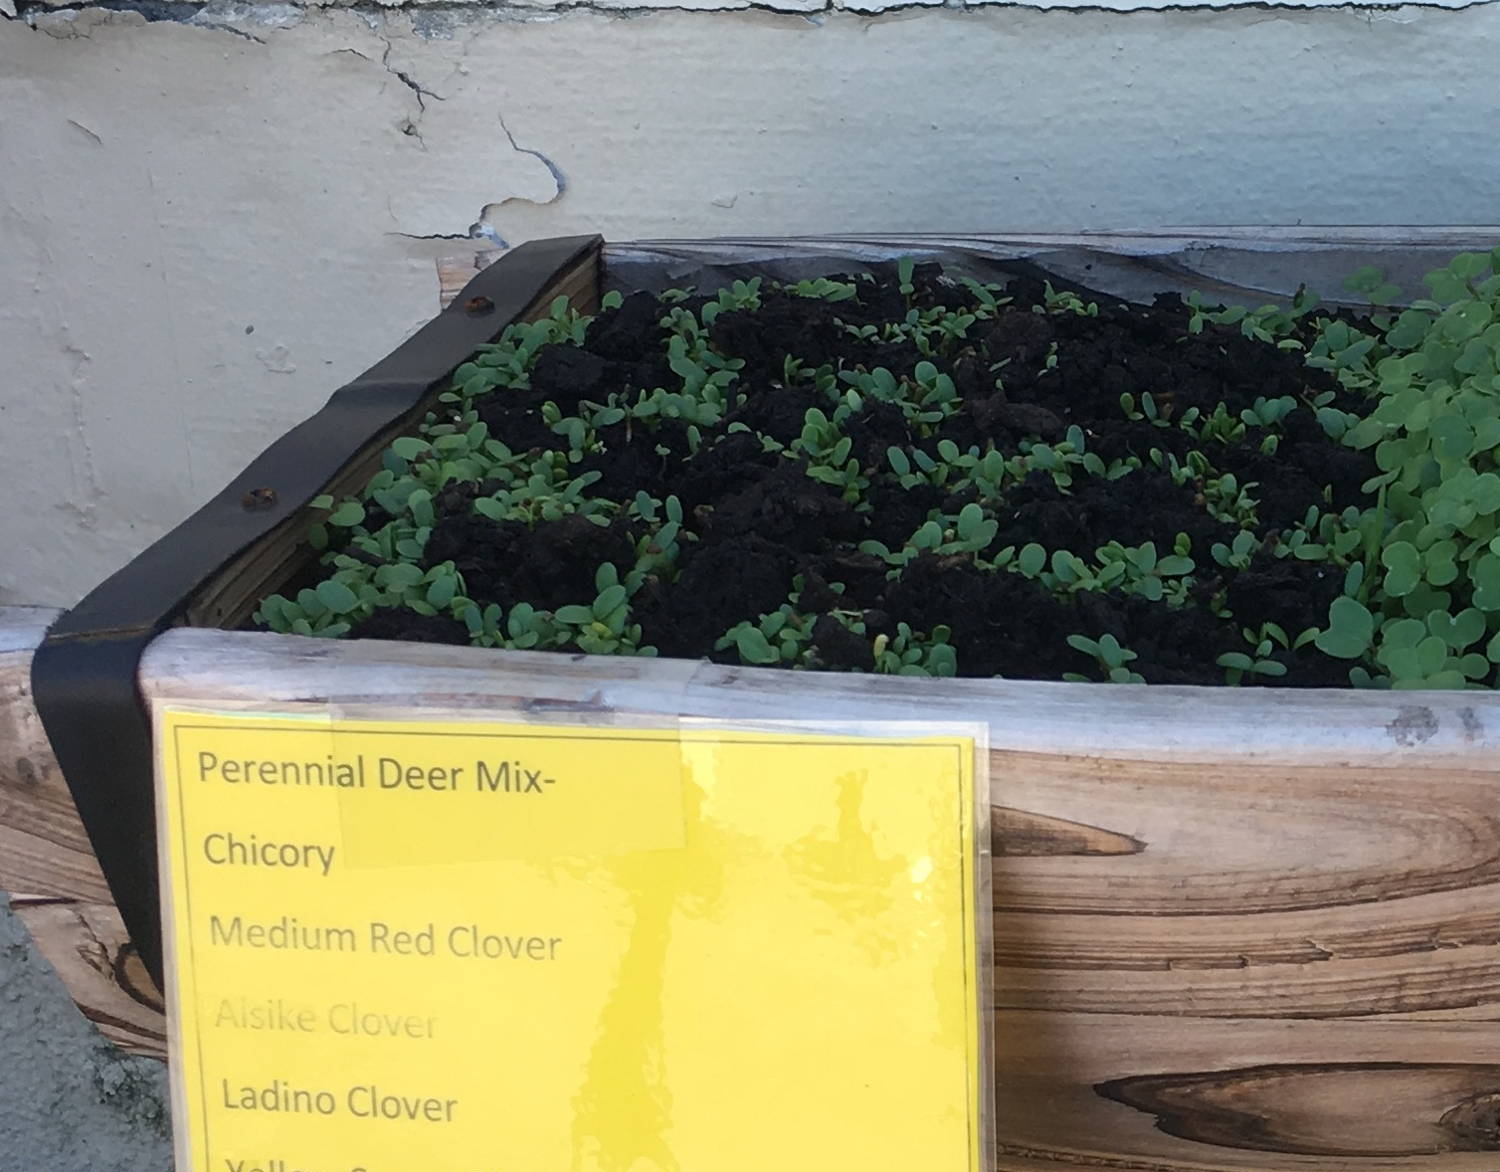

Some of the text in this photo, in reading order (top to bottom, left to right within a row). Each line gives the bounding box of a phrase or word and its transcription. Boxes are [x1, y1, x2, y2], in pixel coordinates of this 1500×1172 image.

[197, 750, 557, 796] Perennial Deer Mix-
[202, 832, 336, 878] Chicory
[209, 915, 562, 963] Medium Red Clover
[214, 997, 438, 1040] Alsike Clover
[220, 1078, 458, 1123] Ladino Clover
